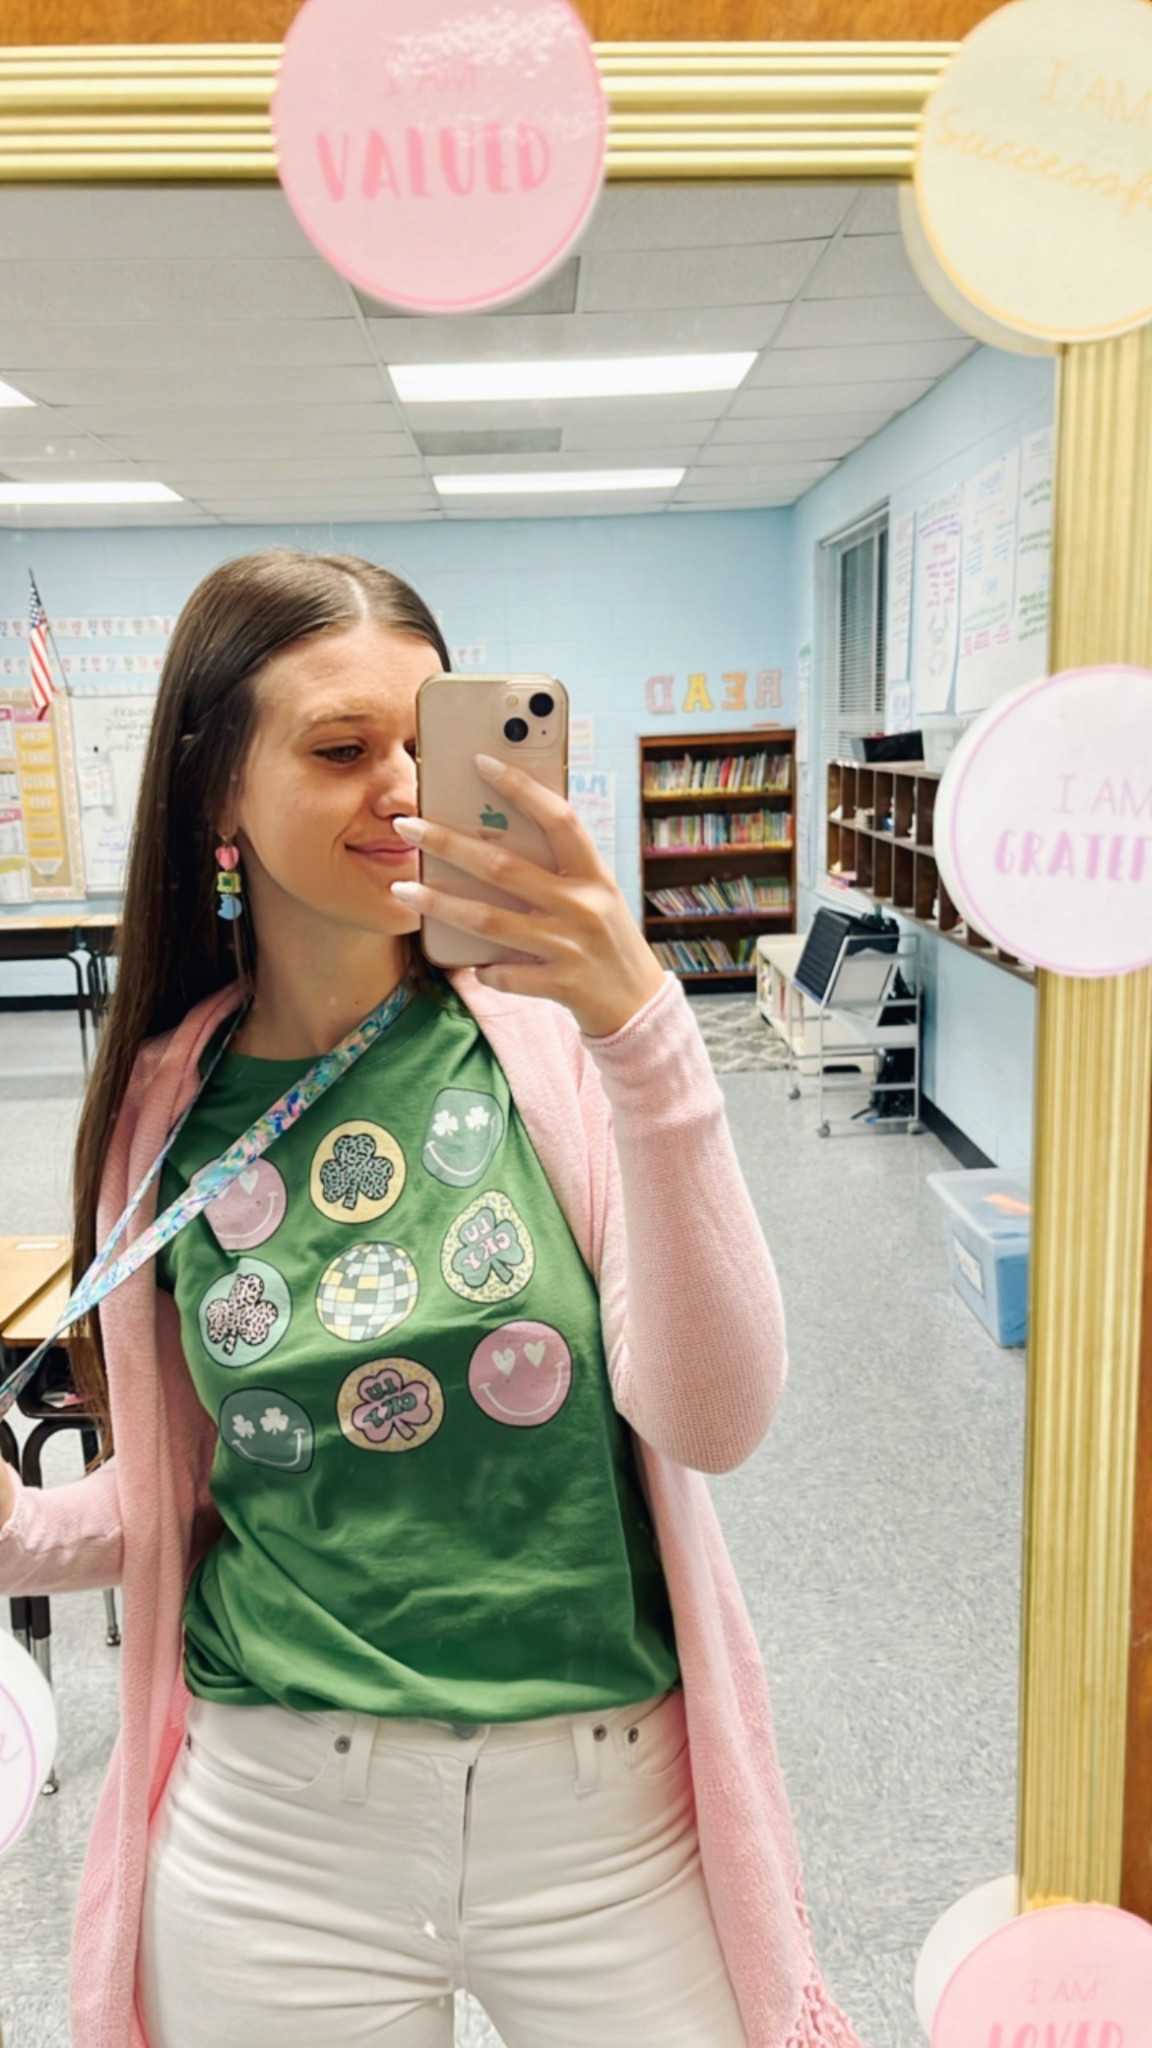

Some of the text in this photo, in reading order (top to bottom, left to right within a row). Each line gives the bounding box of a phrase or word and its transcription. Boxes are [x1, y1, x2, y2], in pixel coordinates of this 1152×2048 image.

[1042, 56, 1152, 128] I AM
[316, 122, 552, 203] VALUED
[1053, 774, 1152, 818] I AM
[1026, 1976, 1100, 2006] I AM
